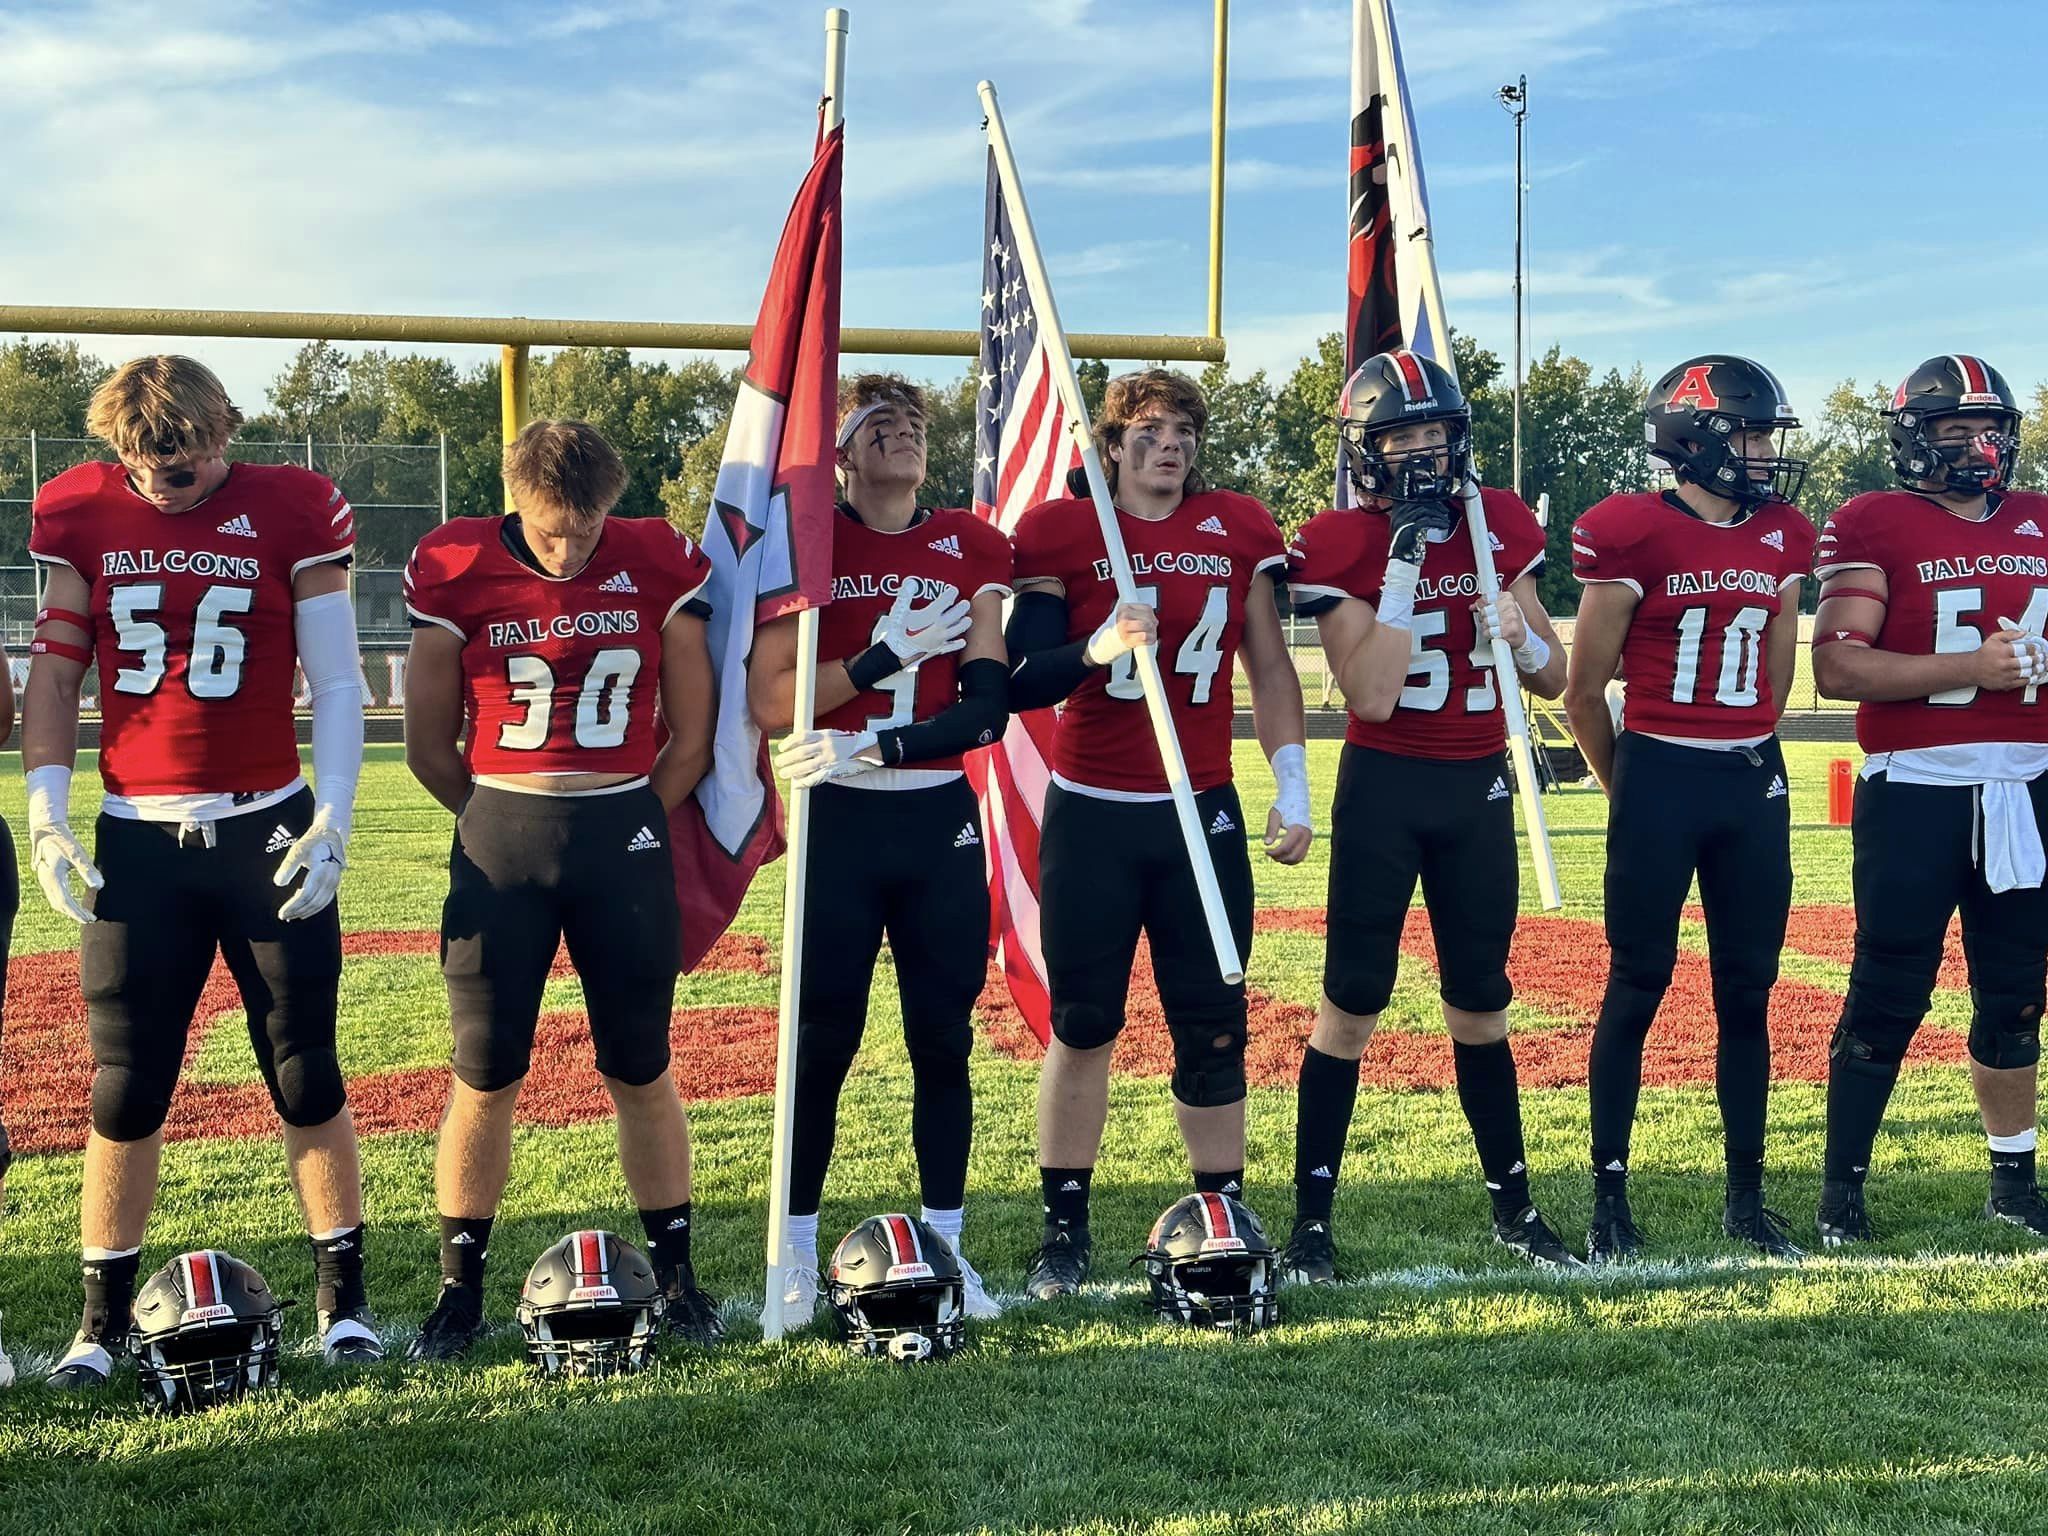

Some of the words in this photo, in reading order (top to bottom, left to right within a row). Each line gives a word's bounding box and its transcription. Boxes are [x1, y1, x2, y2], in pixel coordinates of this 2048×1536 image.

[1665, 366, 1719, 414] A
[1404, 400, 1439, 412] Riddell
[216, 525, 258, 539] adidas
[1195, 523, 1229, 537] adidas
[927, 541, 964, 560] adidas
[102, 550, 260, 580] FALCONS
[1093, 551, 1232, 581] FLCONS
[1916, 554, 2047, 584] FALCONS
[598, 582, 639, 594] adidas
[832, 574, 952, 601] ALCON
[1666, 568, 1778, 597] FALCONS
[109, 581, 256, 699] 56
[488, 609, 639, 648] FALCONS
[1672, 606, 1769, 706] 10
[497, 648, 642, 750] 30
[627, 840, 661, 852] adidas
[892, 1263, 928, 1276] Riddell
[575, 1287, 613, 1299] Riddell
[187, 1306, 228, 1321] Riddell
